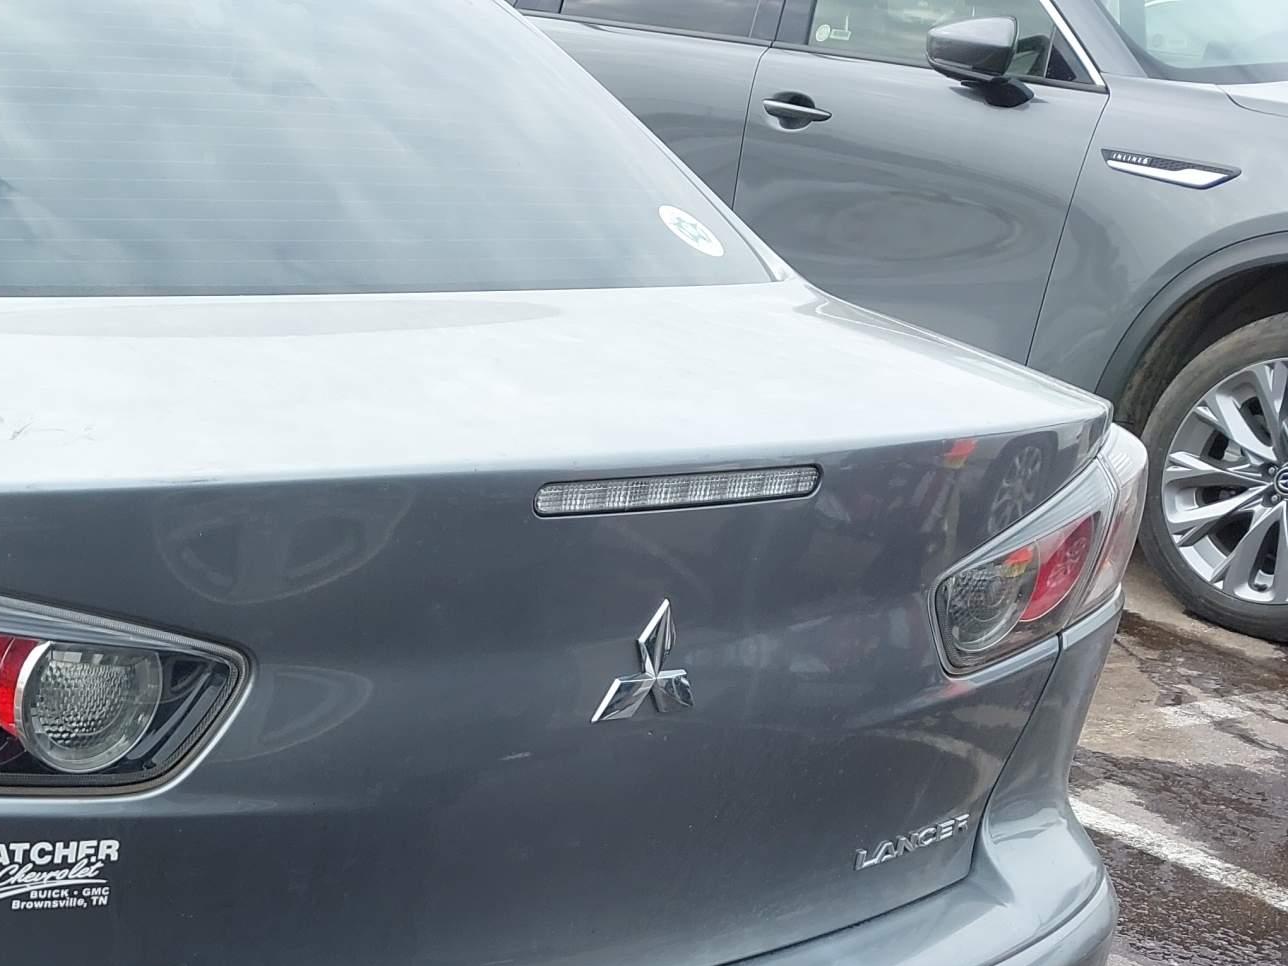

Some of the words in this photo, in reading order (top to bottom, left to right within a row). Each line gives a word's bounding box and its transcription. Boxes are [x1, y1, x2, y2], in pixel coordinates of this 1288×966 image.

[853, 813, 970, 872] LANCER
[29, 888, 69, 899] BUICK
[82, 886, 110, 897] GMC
[11, 897, 88, 910] Brownsville,
[91, 895, 109, 906] TN
